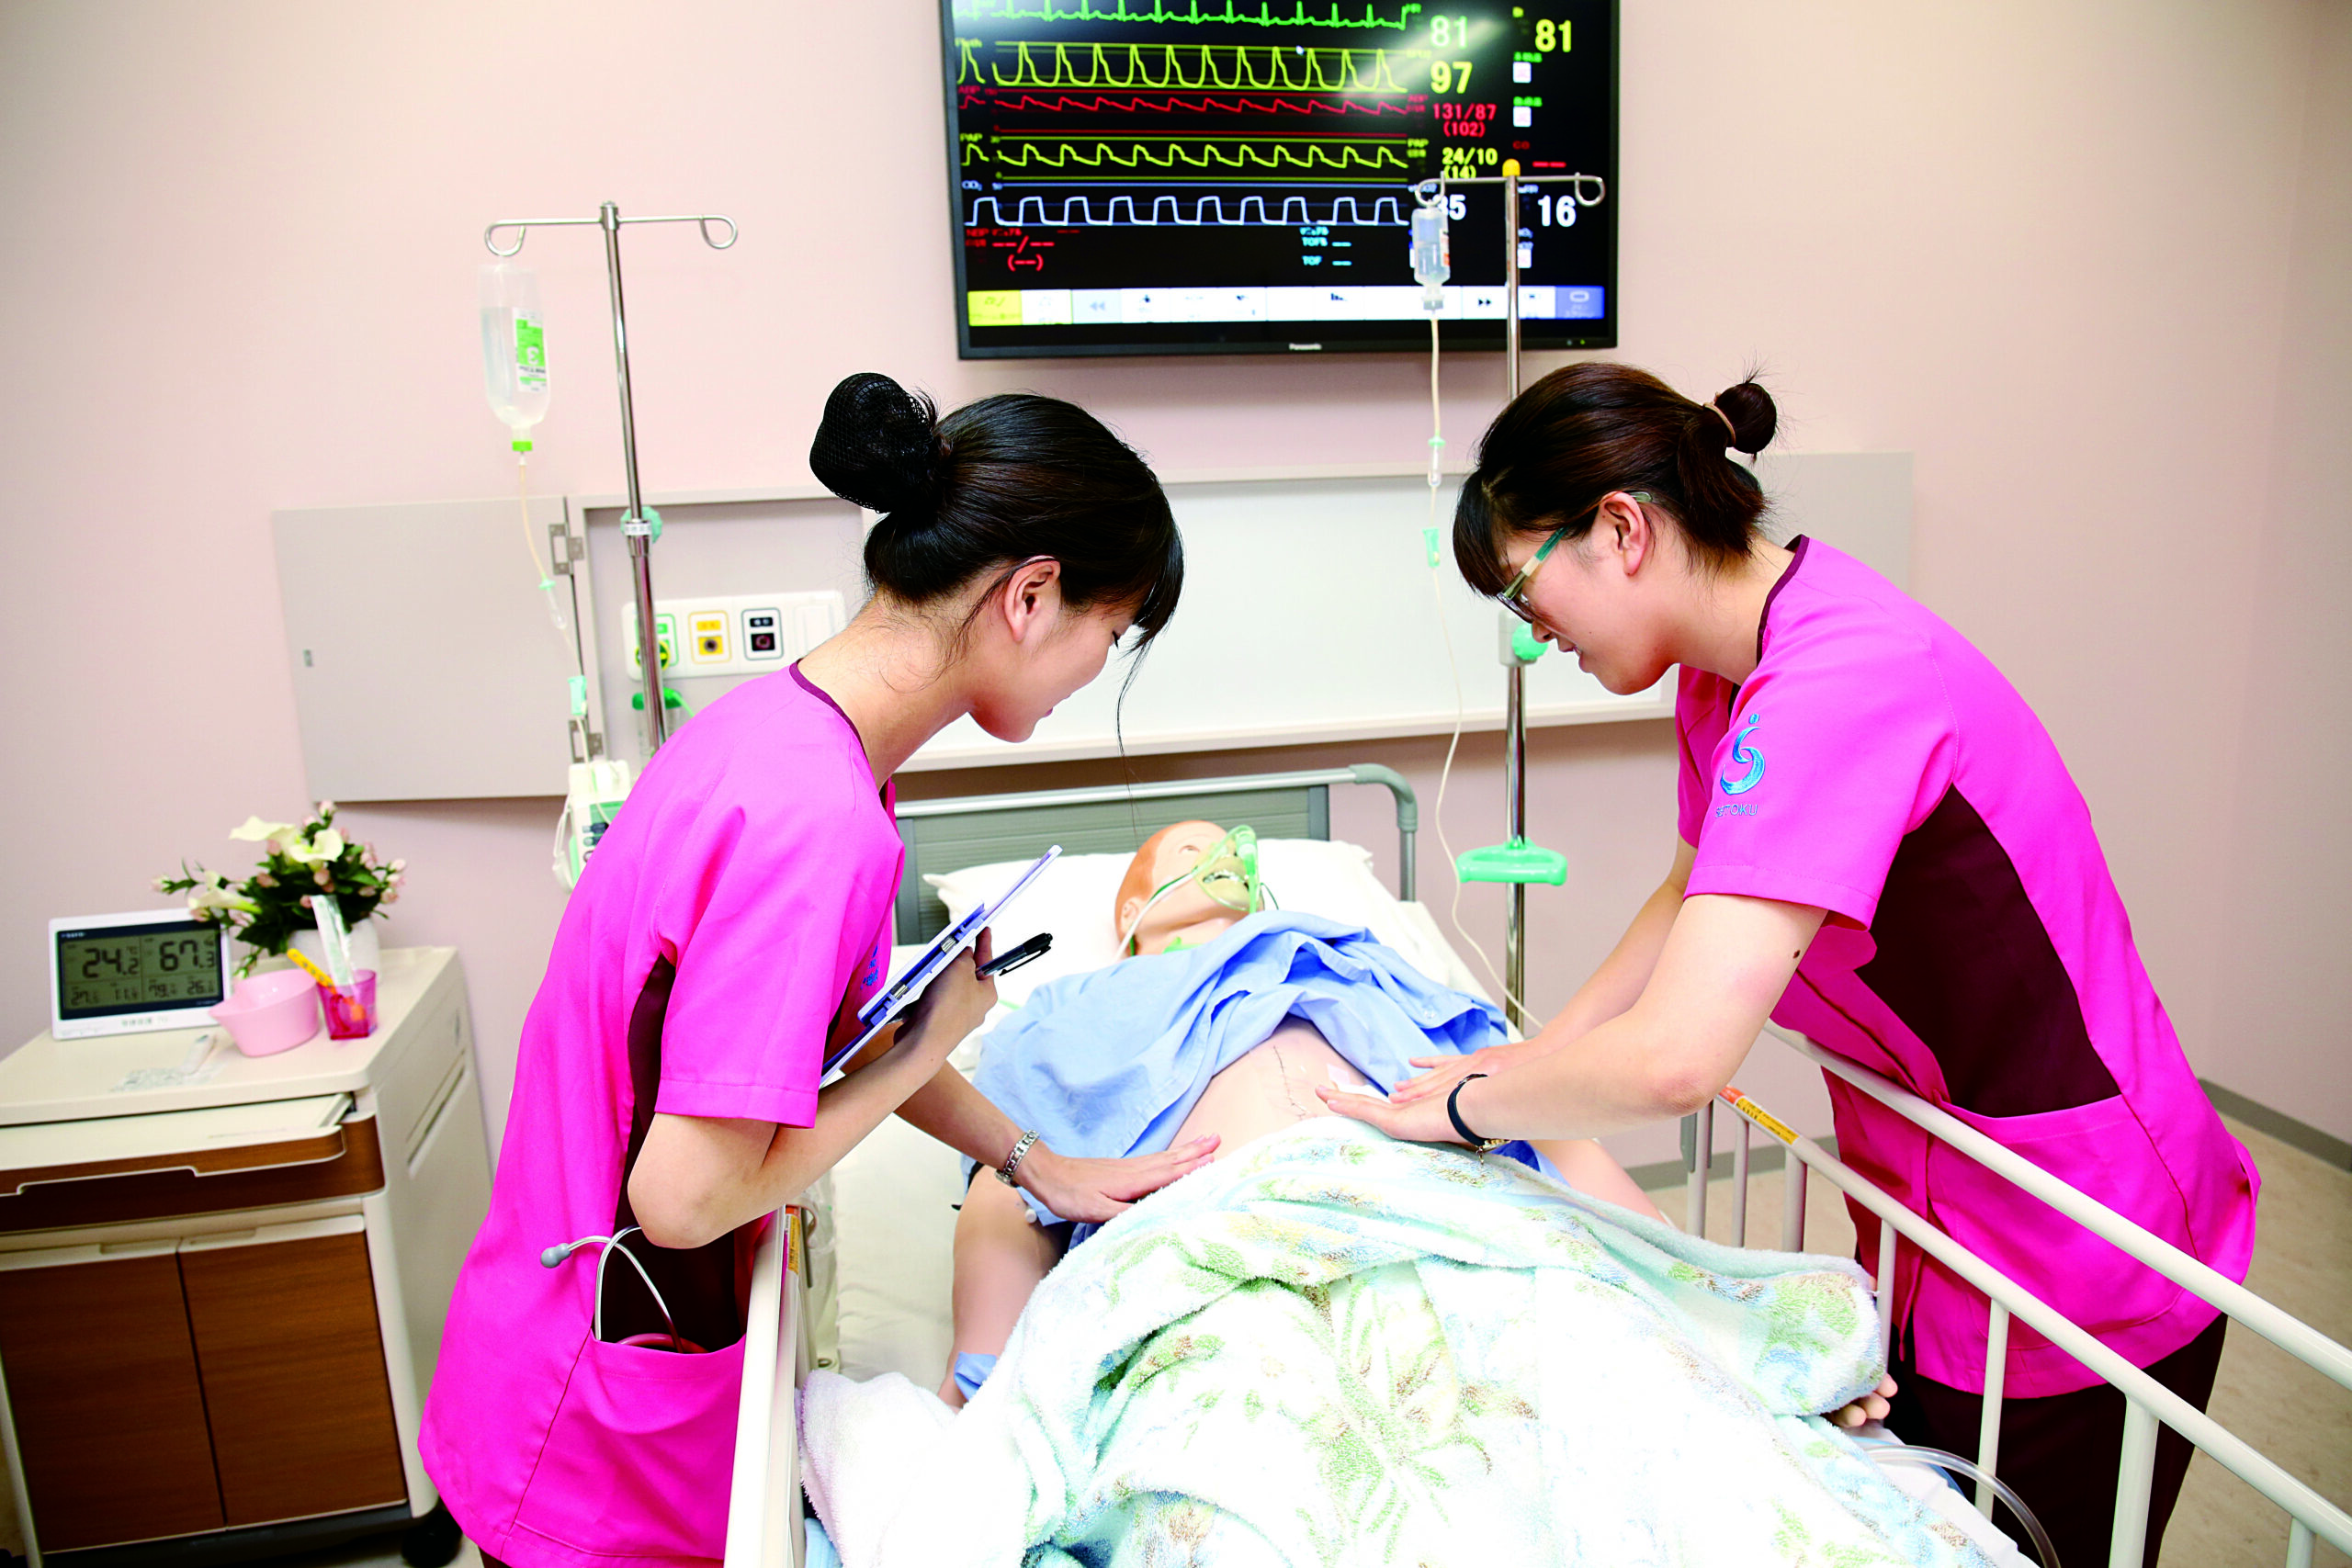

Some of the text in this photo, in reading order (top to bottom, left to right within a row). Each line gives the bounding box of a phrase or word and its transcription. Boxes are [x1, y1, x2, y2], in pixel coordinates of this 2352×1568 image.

[1430, 15, 1468, 49] 81
[1535, 19, 1572, 52] 81
[1430, 61, 1473, 94] 97
[1433, 103, 1497, 121] 131/87
[1443, 121, 1486, 138] (102)
[1442, 147, 1498, 165] 24/10
[1444, 165, 1476, 179] (14)
[1538, 195, 1577, 228] 16
[83, 948, 139, 978] 24.2
[160, 940, 215, 972] 67.3
